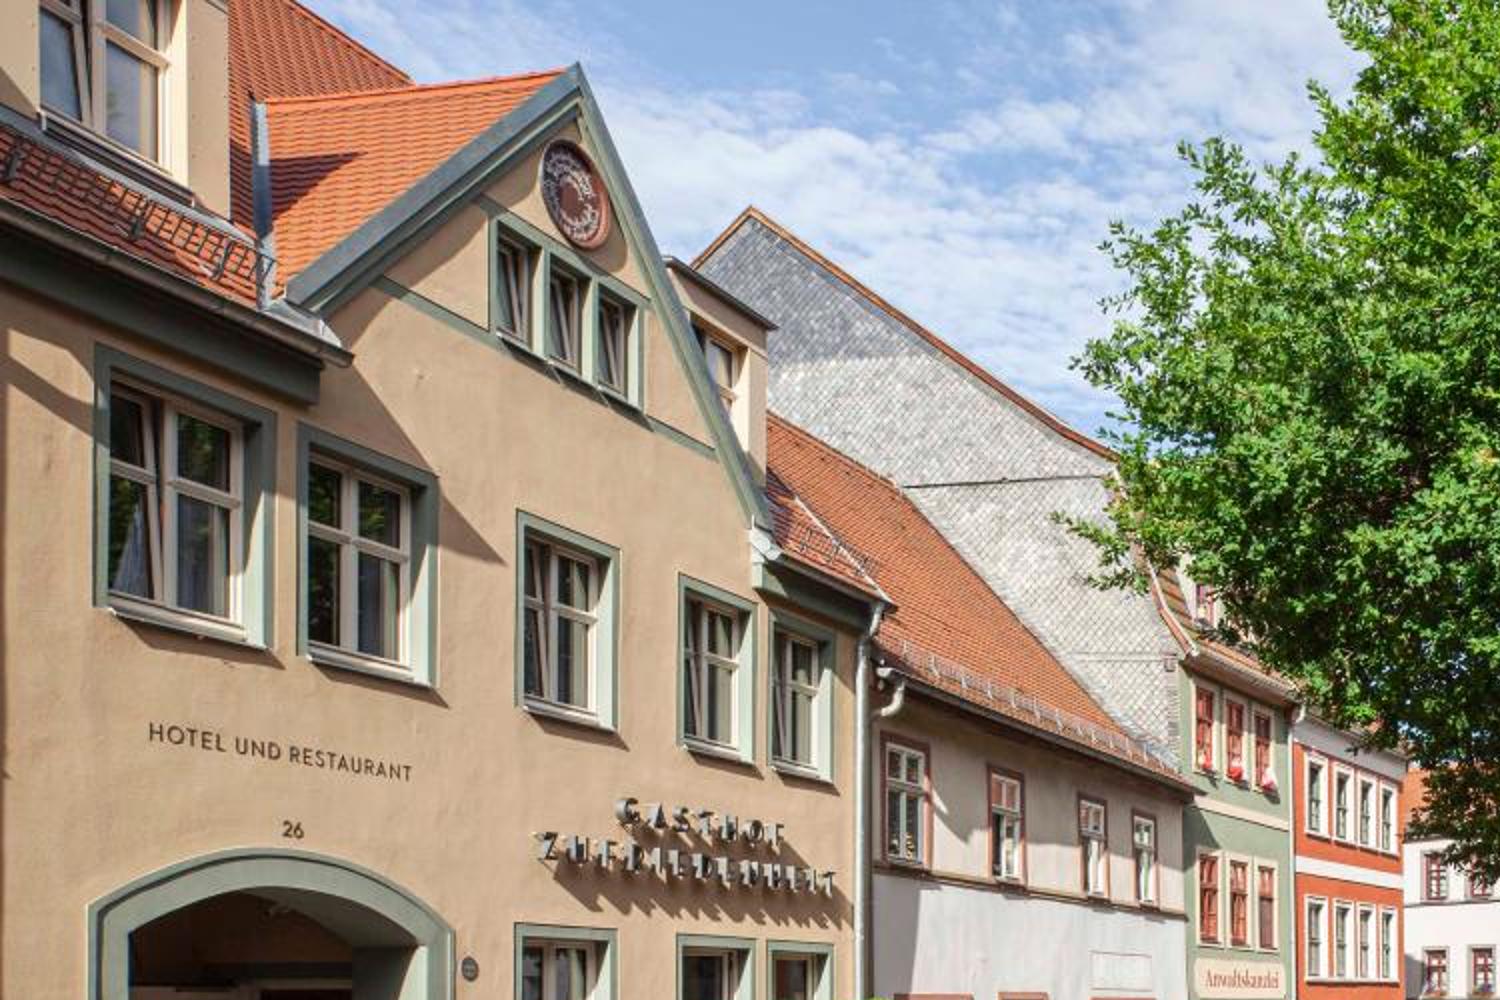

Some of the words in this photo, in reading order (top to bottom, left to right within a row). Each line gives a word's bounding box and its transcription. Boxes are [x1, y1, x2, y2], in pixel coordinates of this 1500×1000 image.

[149, 722, 226, 752] HOTEL
[235, 737, 282, 760] UND
[289, 746, 414, 782] RESTAURANT
[282, 820, 305, 840] 26
[614, 797, 786, 850] GASTHOF
[537, 831, 836, 897] ZUFRIEDENHEIT
[1205, 967, 1280, 989] Anwaltskanzlei
